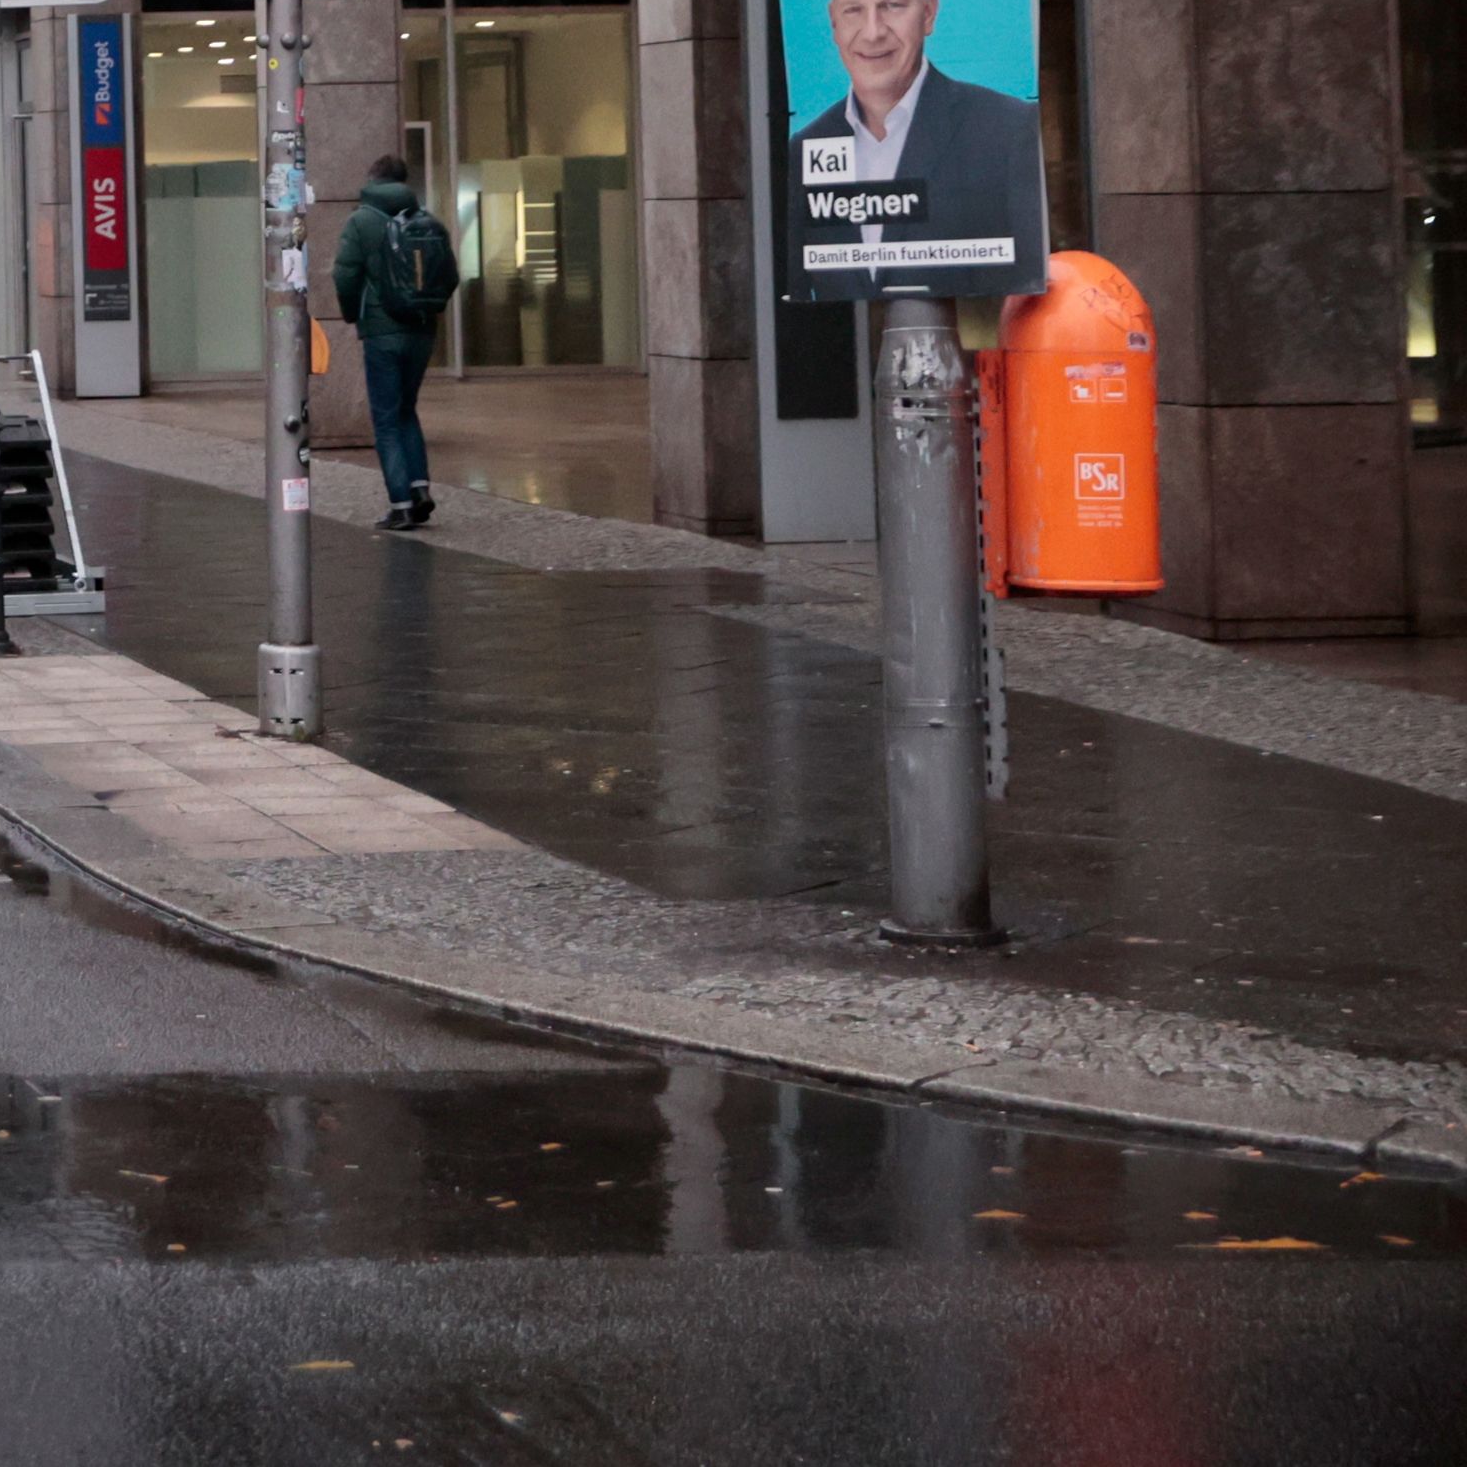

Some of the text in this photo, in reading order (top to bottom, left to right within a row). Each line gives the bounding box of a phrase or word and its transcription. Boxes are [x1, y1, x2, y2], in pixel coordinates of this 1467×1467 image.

[94, 41, 115, 103] Budget
[809, 146, 848, 173] Kai
[93, 177, 117, 240] AVIS
[807, 191, 920, 224] Wegner
[808, 243, 1010, 264] Damit Berlin funktioniert.
[1079, 462, 1119, 492] BSR
